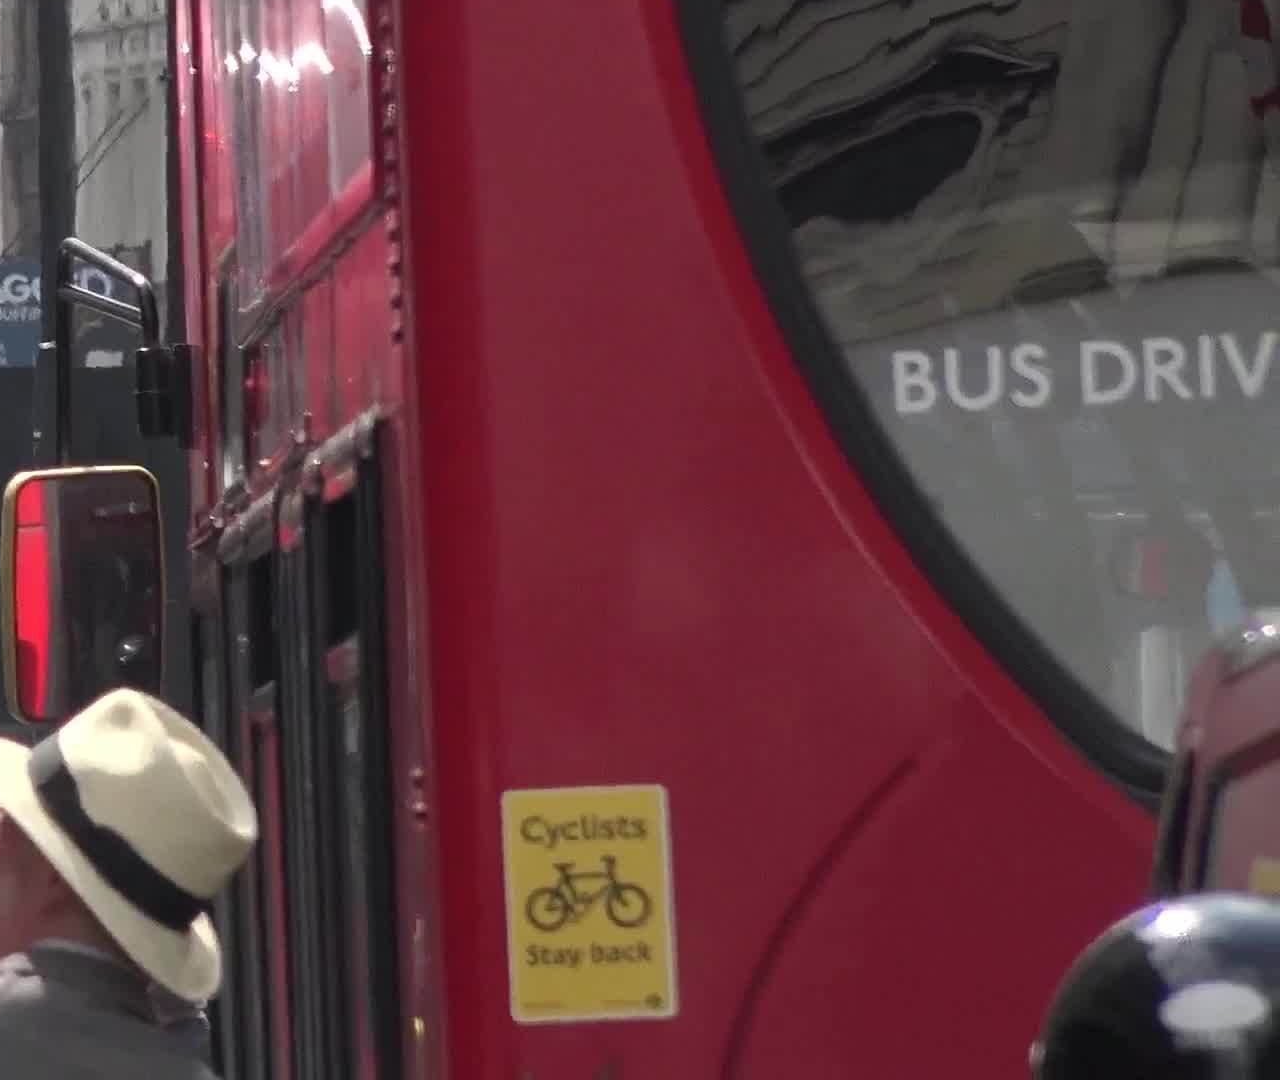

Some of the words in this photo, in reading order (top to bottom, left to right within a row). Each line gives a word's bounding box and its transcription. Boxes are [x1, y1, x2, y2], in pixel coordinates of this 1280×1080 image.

[892, 342, 1052, 414] BUS
[1079, 331, 1280, 406] DRIV
[519, 813, 648, 849] Cyclists
[525, 944, 580, 968] Stay
[591, 941, 653, 964] back
